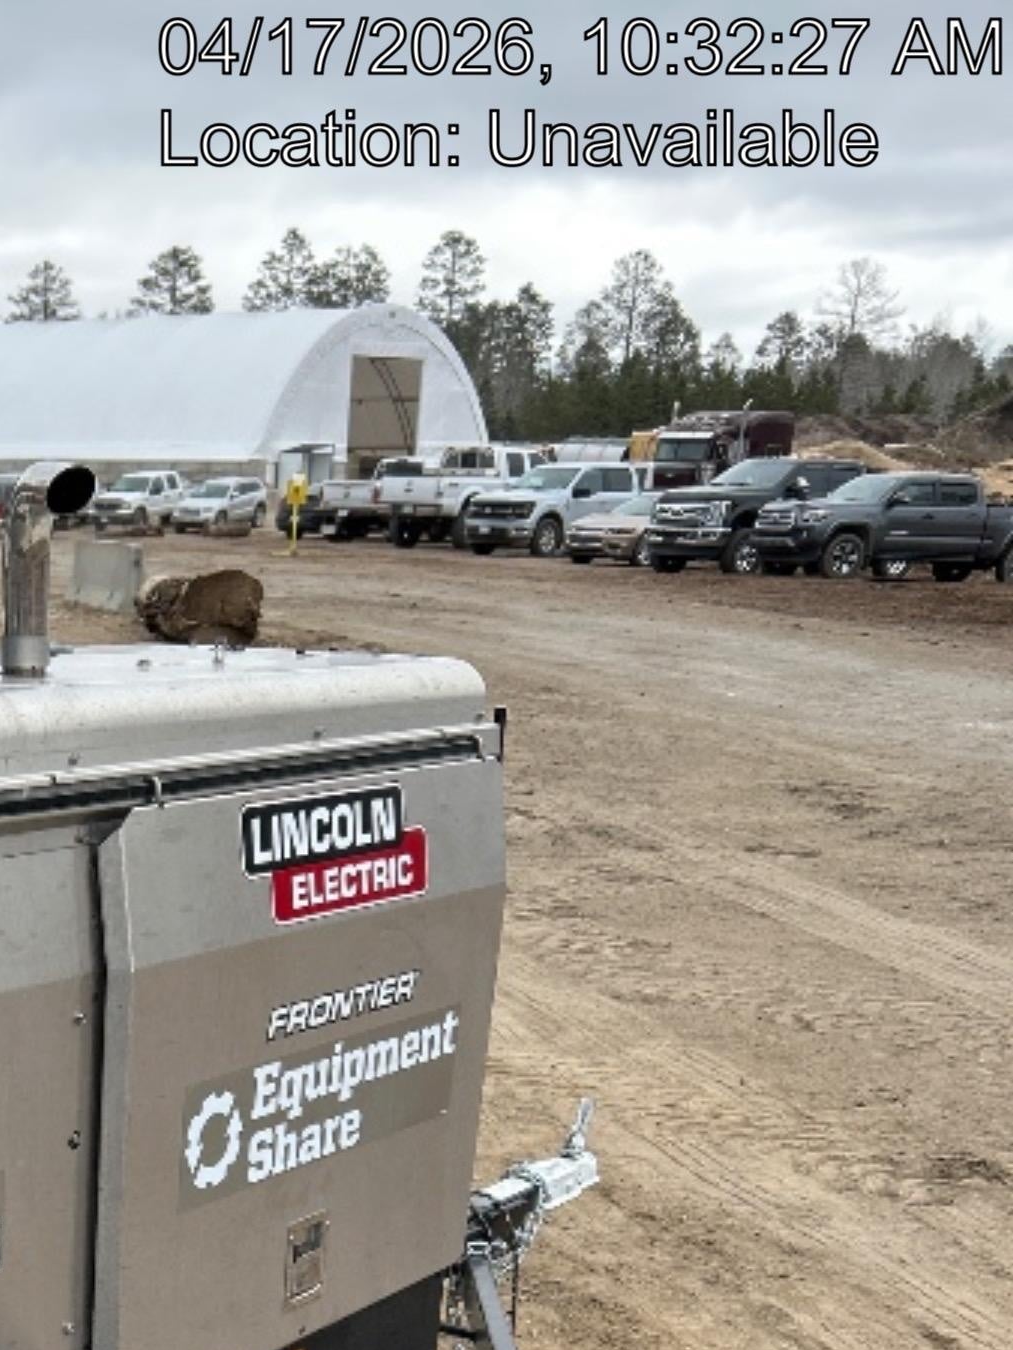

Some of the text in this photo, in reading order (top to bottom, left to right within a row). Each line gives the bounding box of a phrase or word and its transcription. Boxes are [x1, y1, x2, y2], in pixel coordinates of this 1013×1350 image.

[250, 796, 397, 866] LINCOLN
[291, 853, 415, 910] ELECTRIC
[266, 972, 417, 1042] FRONTIER
[250, 1010, 461, 1122] Equipment
[247, 1108, 363, 1184] Share
